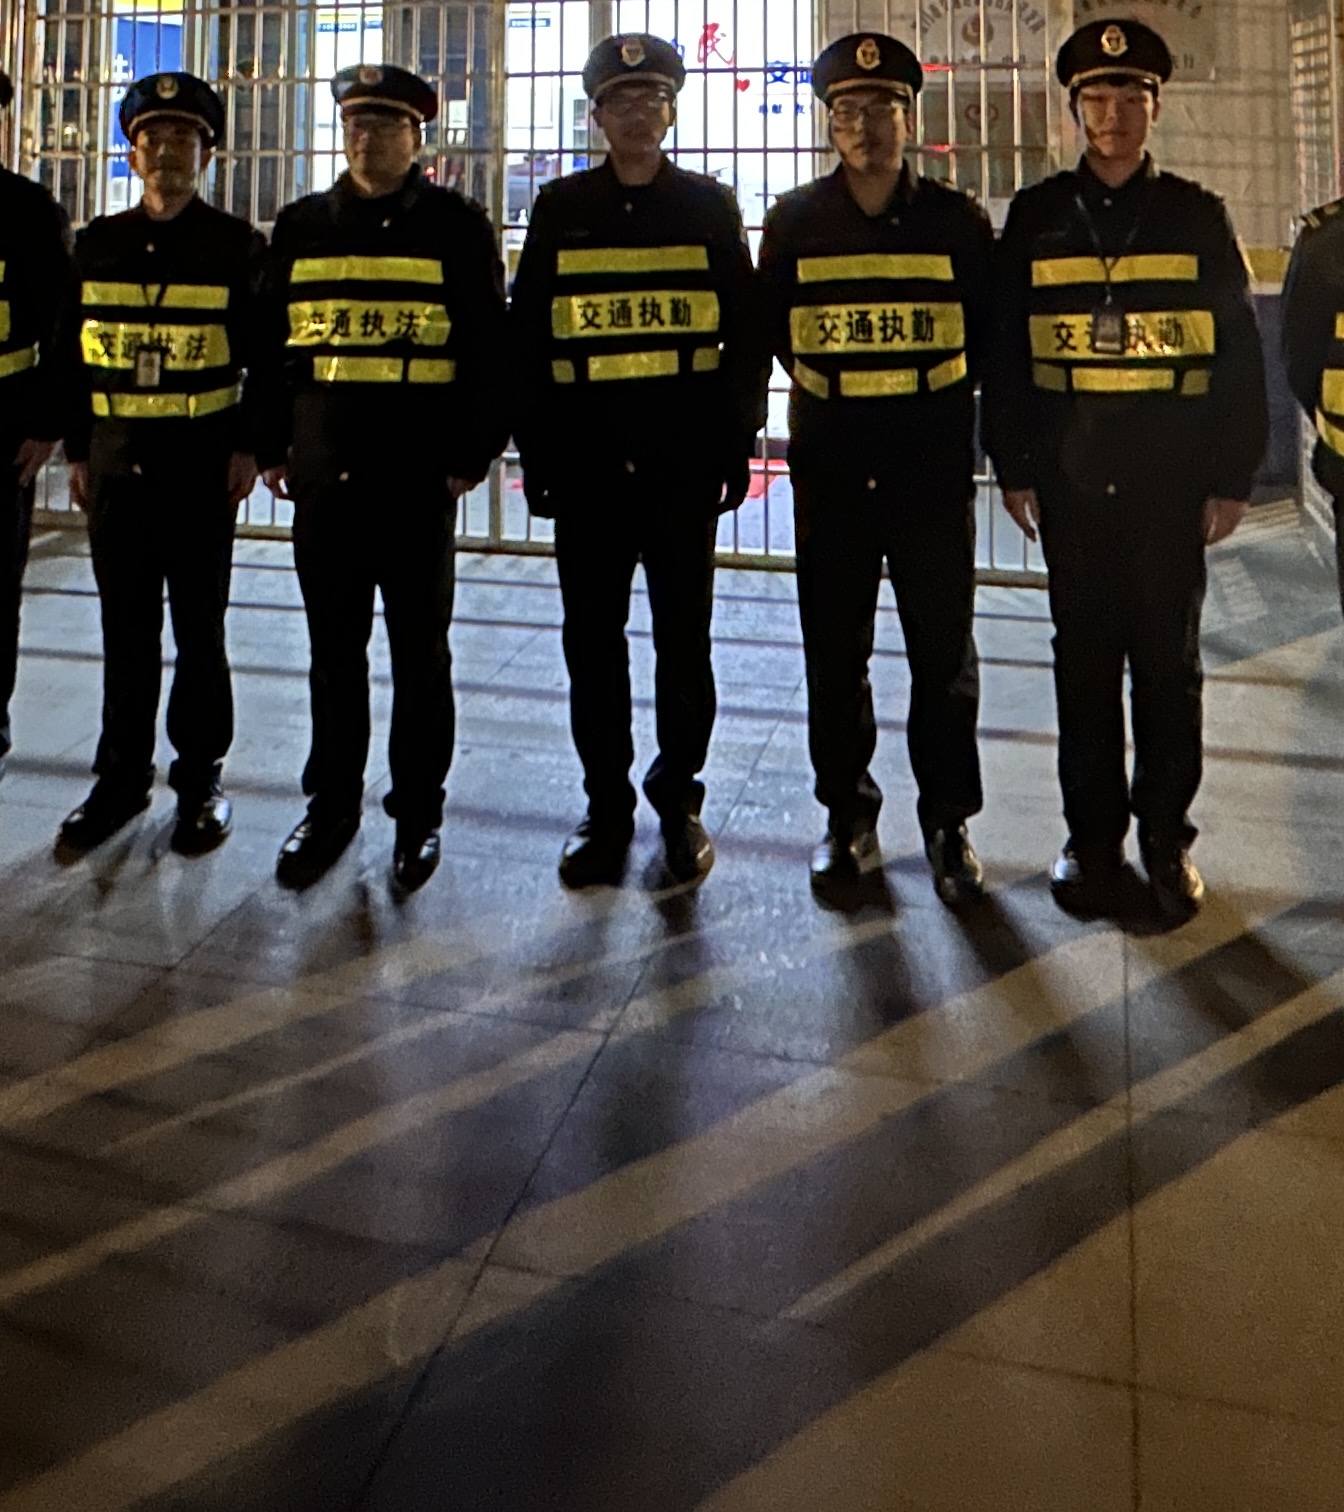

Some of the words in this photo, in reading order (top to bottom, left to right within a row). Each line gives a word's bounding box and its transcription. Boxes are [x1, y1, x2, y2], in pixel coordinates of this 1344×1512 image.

[578, 295, 692, 329] 交通执勤
[816, 306, 935, 343] 交通执勤
[1053, 316, 1185, 350] 交执勤
